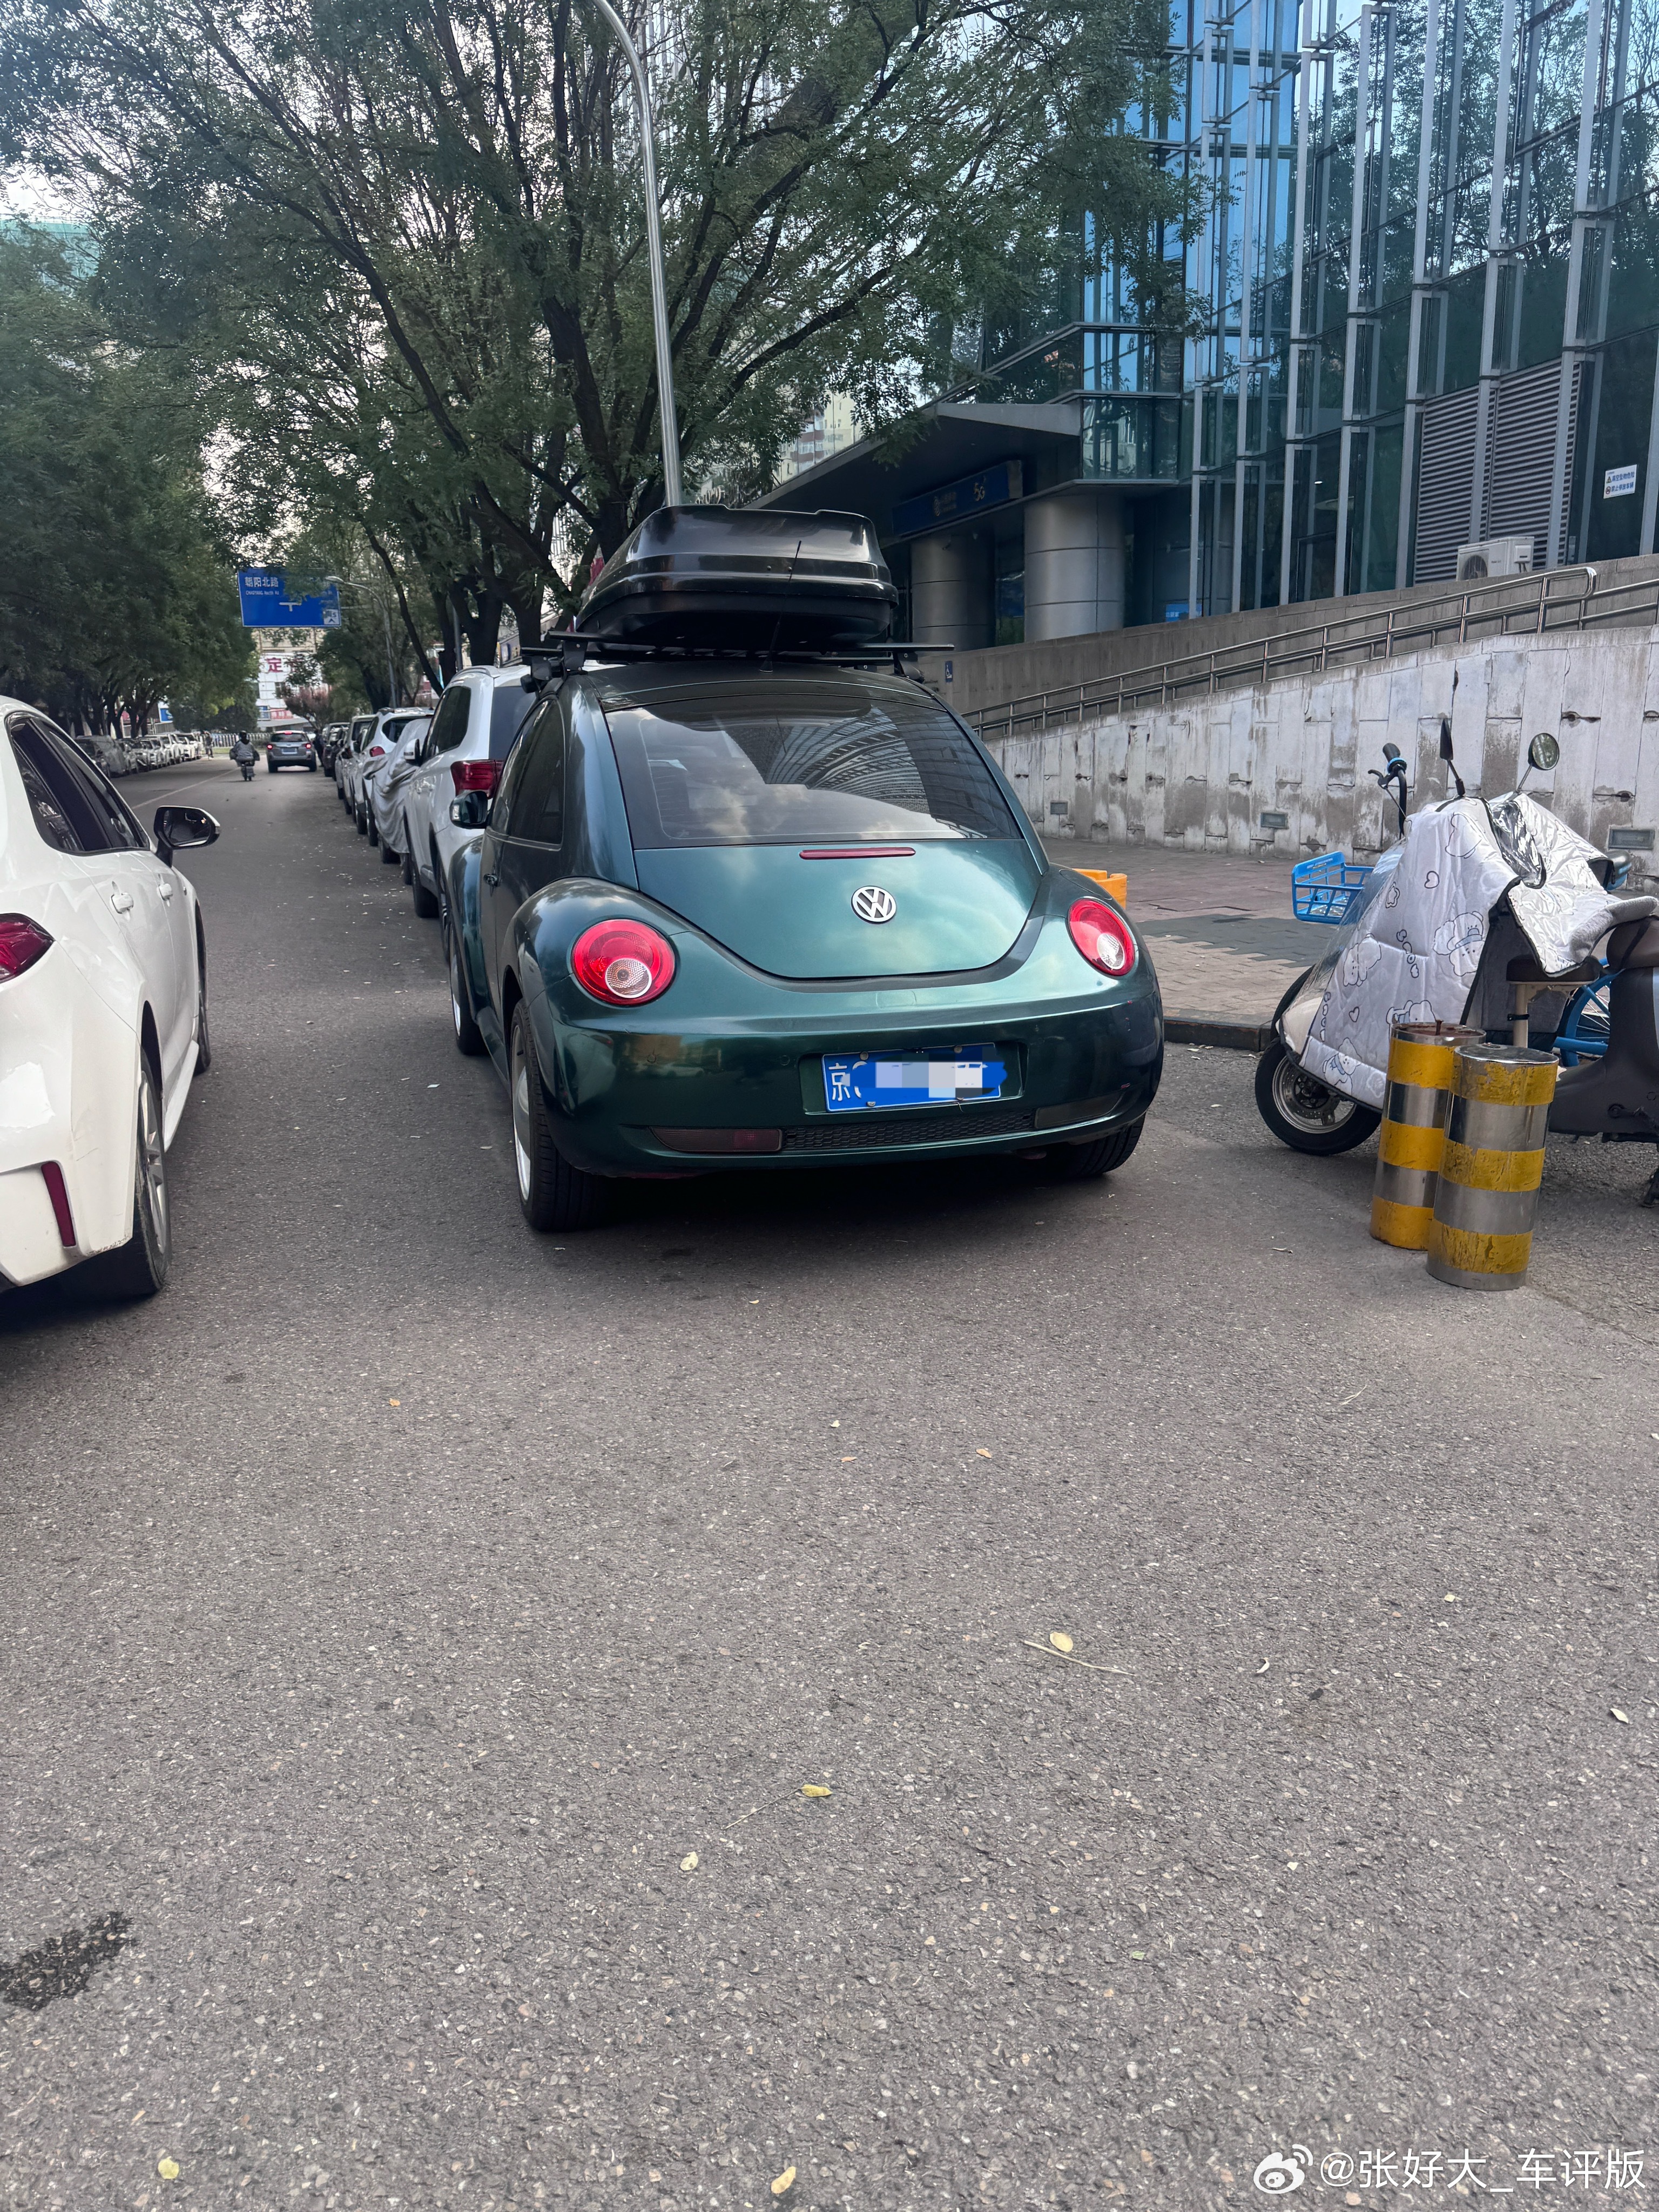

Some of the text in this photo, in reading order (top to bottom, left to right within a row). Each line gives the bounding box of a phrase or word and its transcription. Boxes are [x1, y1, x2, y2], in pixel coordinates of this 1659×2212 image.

[974, 482, 985, 501] 5G
[245, 577, 279, 587] 朝阳北路
